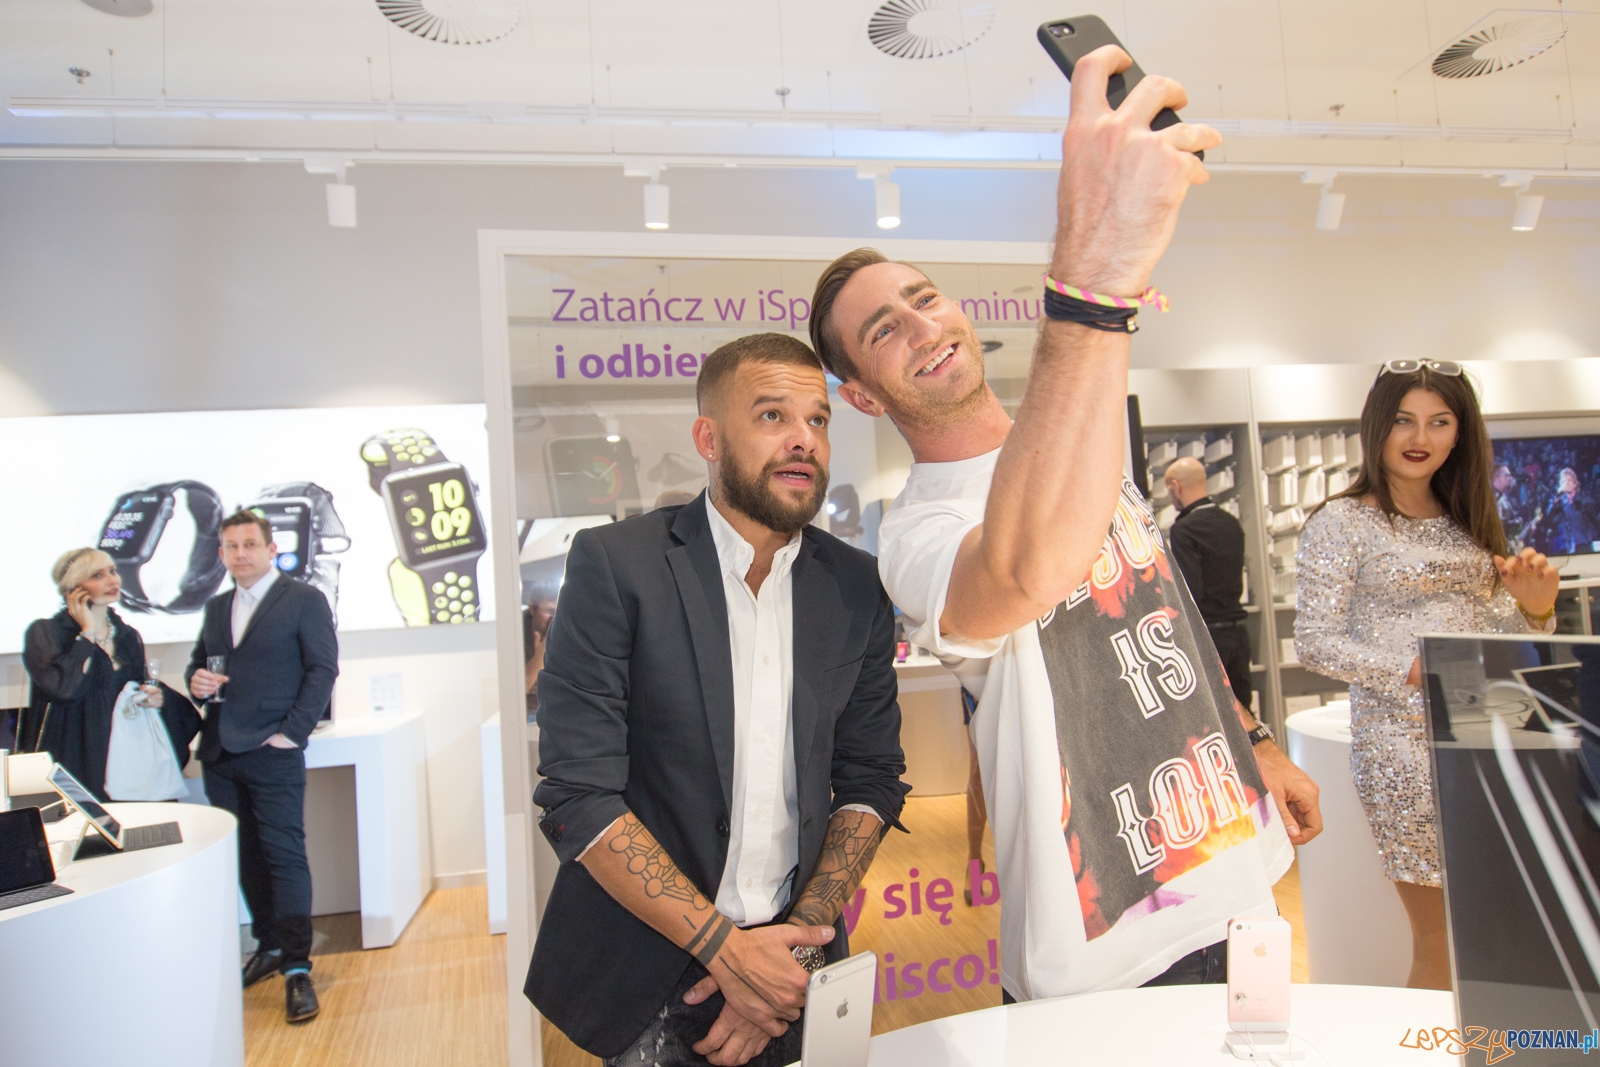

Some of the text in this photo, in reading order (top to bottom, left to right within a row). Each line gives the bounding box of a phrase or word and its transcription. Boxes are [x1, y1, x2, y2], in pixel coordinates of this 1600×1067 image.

[552, 288, 704, 322] Zatańcz
[714, 298, 746, 321] w
[961, 291, 1046, 321] minu
[555, 343, 708, 379] i odbie
[429, 479, 466, 513] 10
[431, 506, 472, 542] 09
[1110, 610, 1197, 719] IS
[1110, 732, 1250, 876] LOR
[883, 867, 955, 926] się
